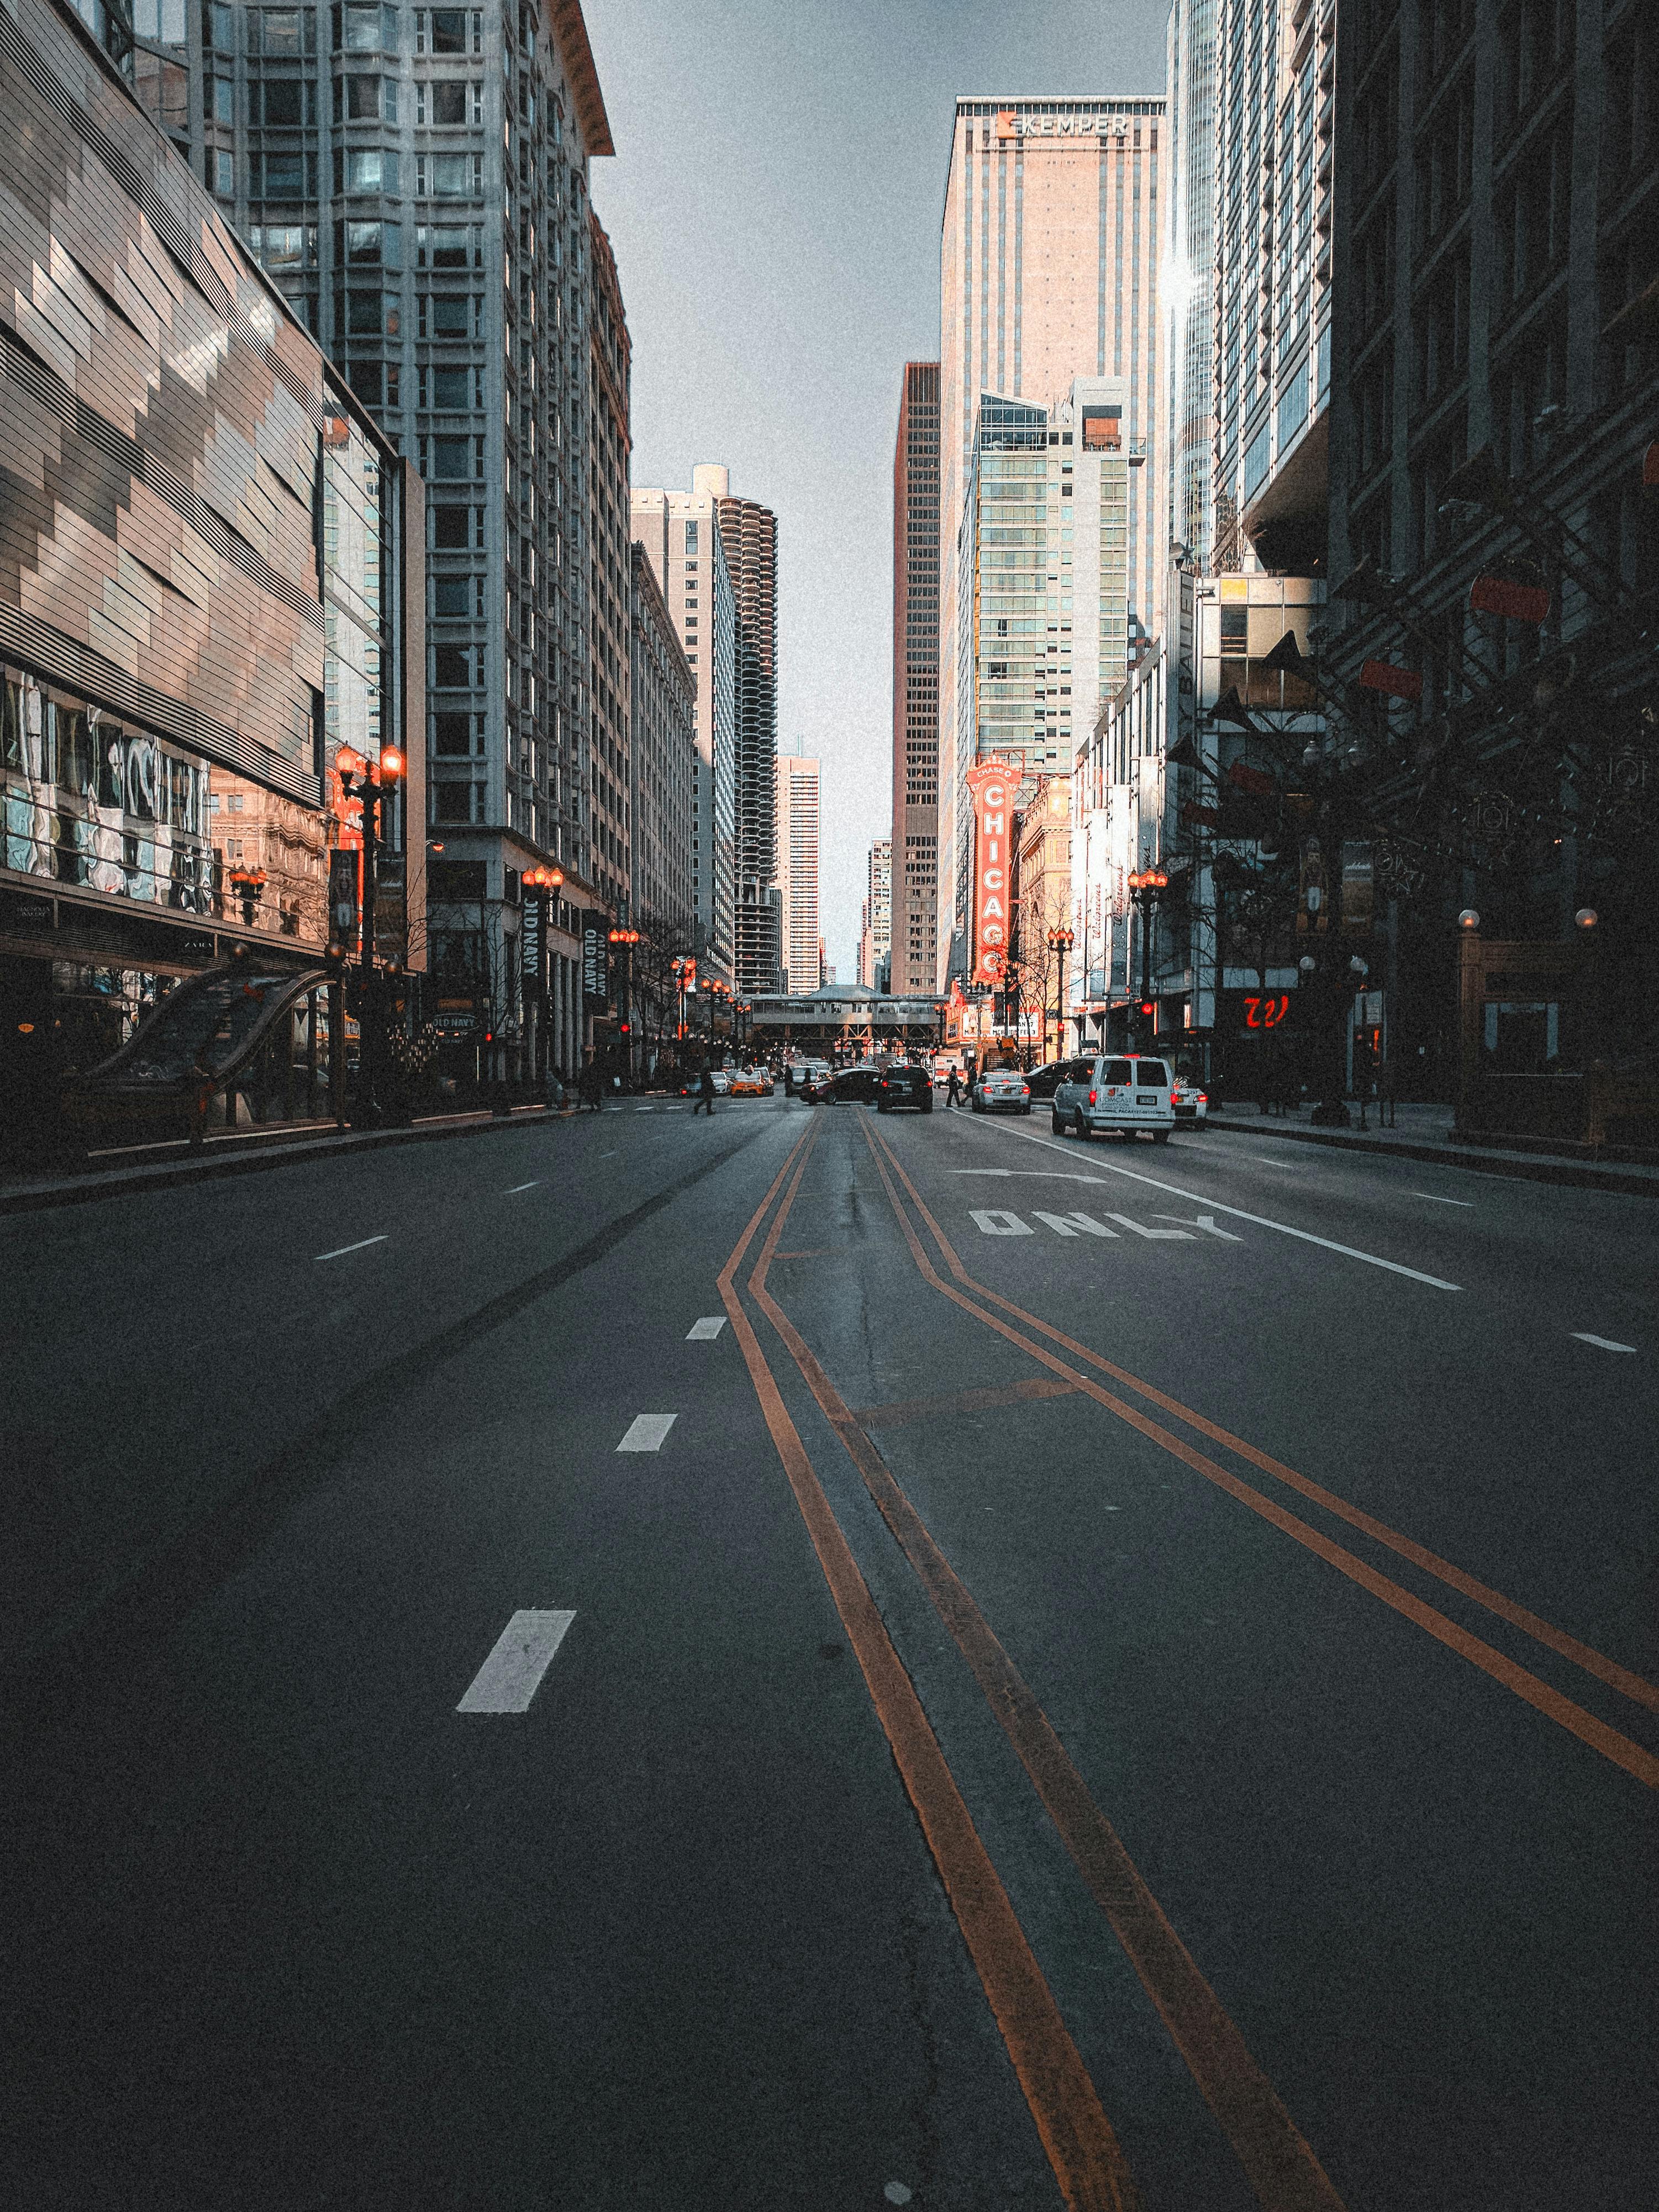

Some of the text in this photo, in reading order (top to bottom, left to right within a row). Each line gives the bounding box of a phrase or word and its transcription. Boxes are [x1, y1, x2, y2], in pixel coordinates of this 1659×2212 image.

[1022, 114, 1128, 135] KEMPER
[977, 767, 1004, 778] CHASE
[982, 784, 1004, 973] CHICAGO
[1113, 865, 1126, 926] Walgreens
[1092, 883, 1103, 939] Walgreens
[523, 932, 539, 977] NAVY
[585, 929, 597, 995] OLD NAVY
[433, 1018, 475, 1026] OLD NAVY
[968, 1210, 1244, 1241] ONLY
